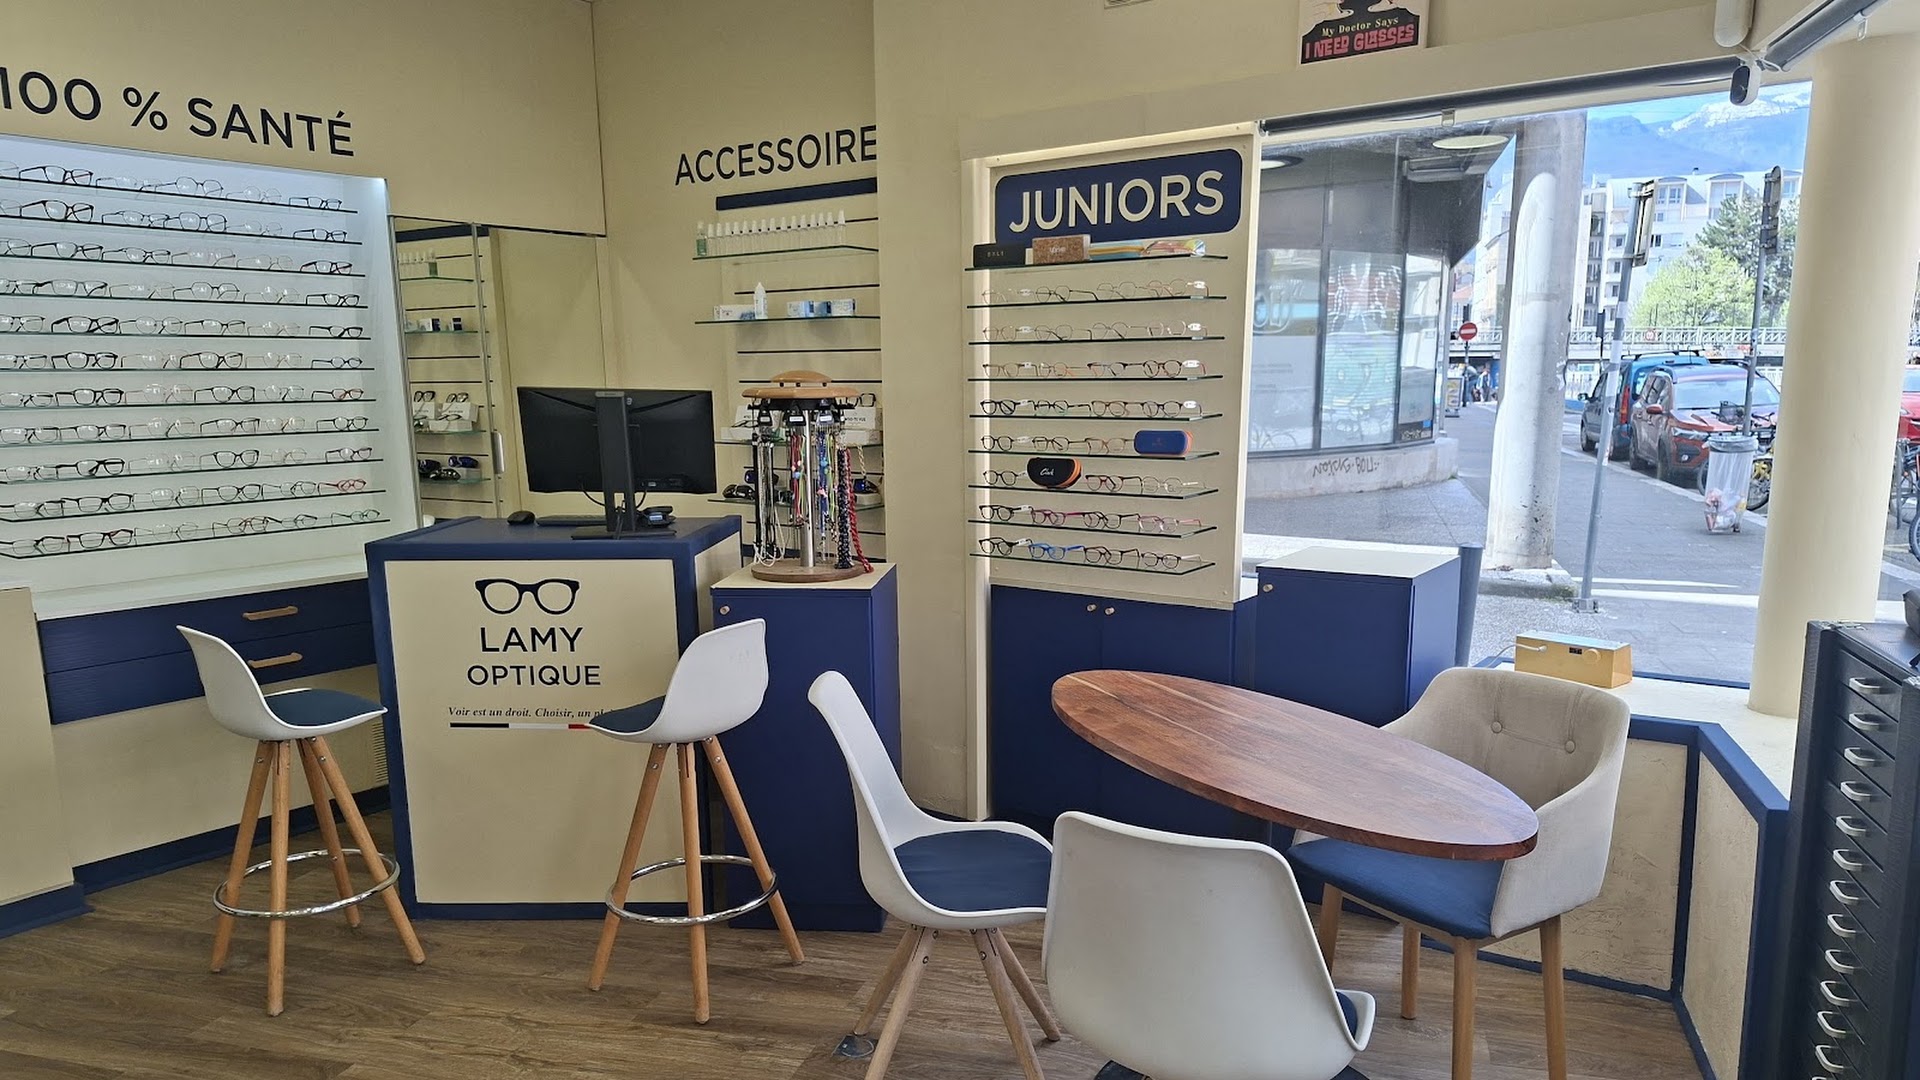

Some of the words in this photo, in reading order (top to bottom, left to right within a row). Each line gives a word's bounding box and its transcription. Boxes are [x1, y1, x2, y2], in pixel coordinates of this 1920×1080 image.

[1305, 42, 1310, 59] I
[1314, 35, 1350, 58] NEED
[1353, 23, 1415, 51] GLASSES
[1321, 27, 1335, 37] My
[1338, 21, 1372, 34] Doctor
[1375, 16, 1399, 28] Says
[0, 66, 102, 121] 100
[122, 86, 169, 131] %
[187, 97, 355, 157] SANTÉ
[675, 124, 877, 186] ACCESSOIRE
[1008, 170, 1225, 233] JUNIORS
[480, 626, 583, 652] LAMY
[467, 665, 601, 686] OPTIQUE
[448, 707, 470, 717] Voir
[472, 707, 486, 717] est
[489, 708, 502, 717] un
[505, 707, 532, 718] droit.
[535, 707, 575, 720] Choisir,
[577, 710, 591, 718] un
